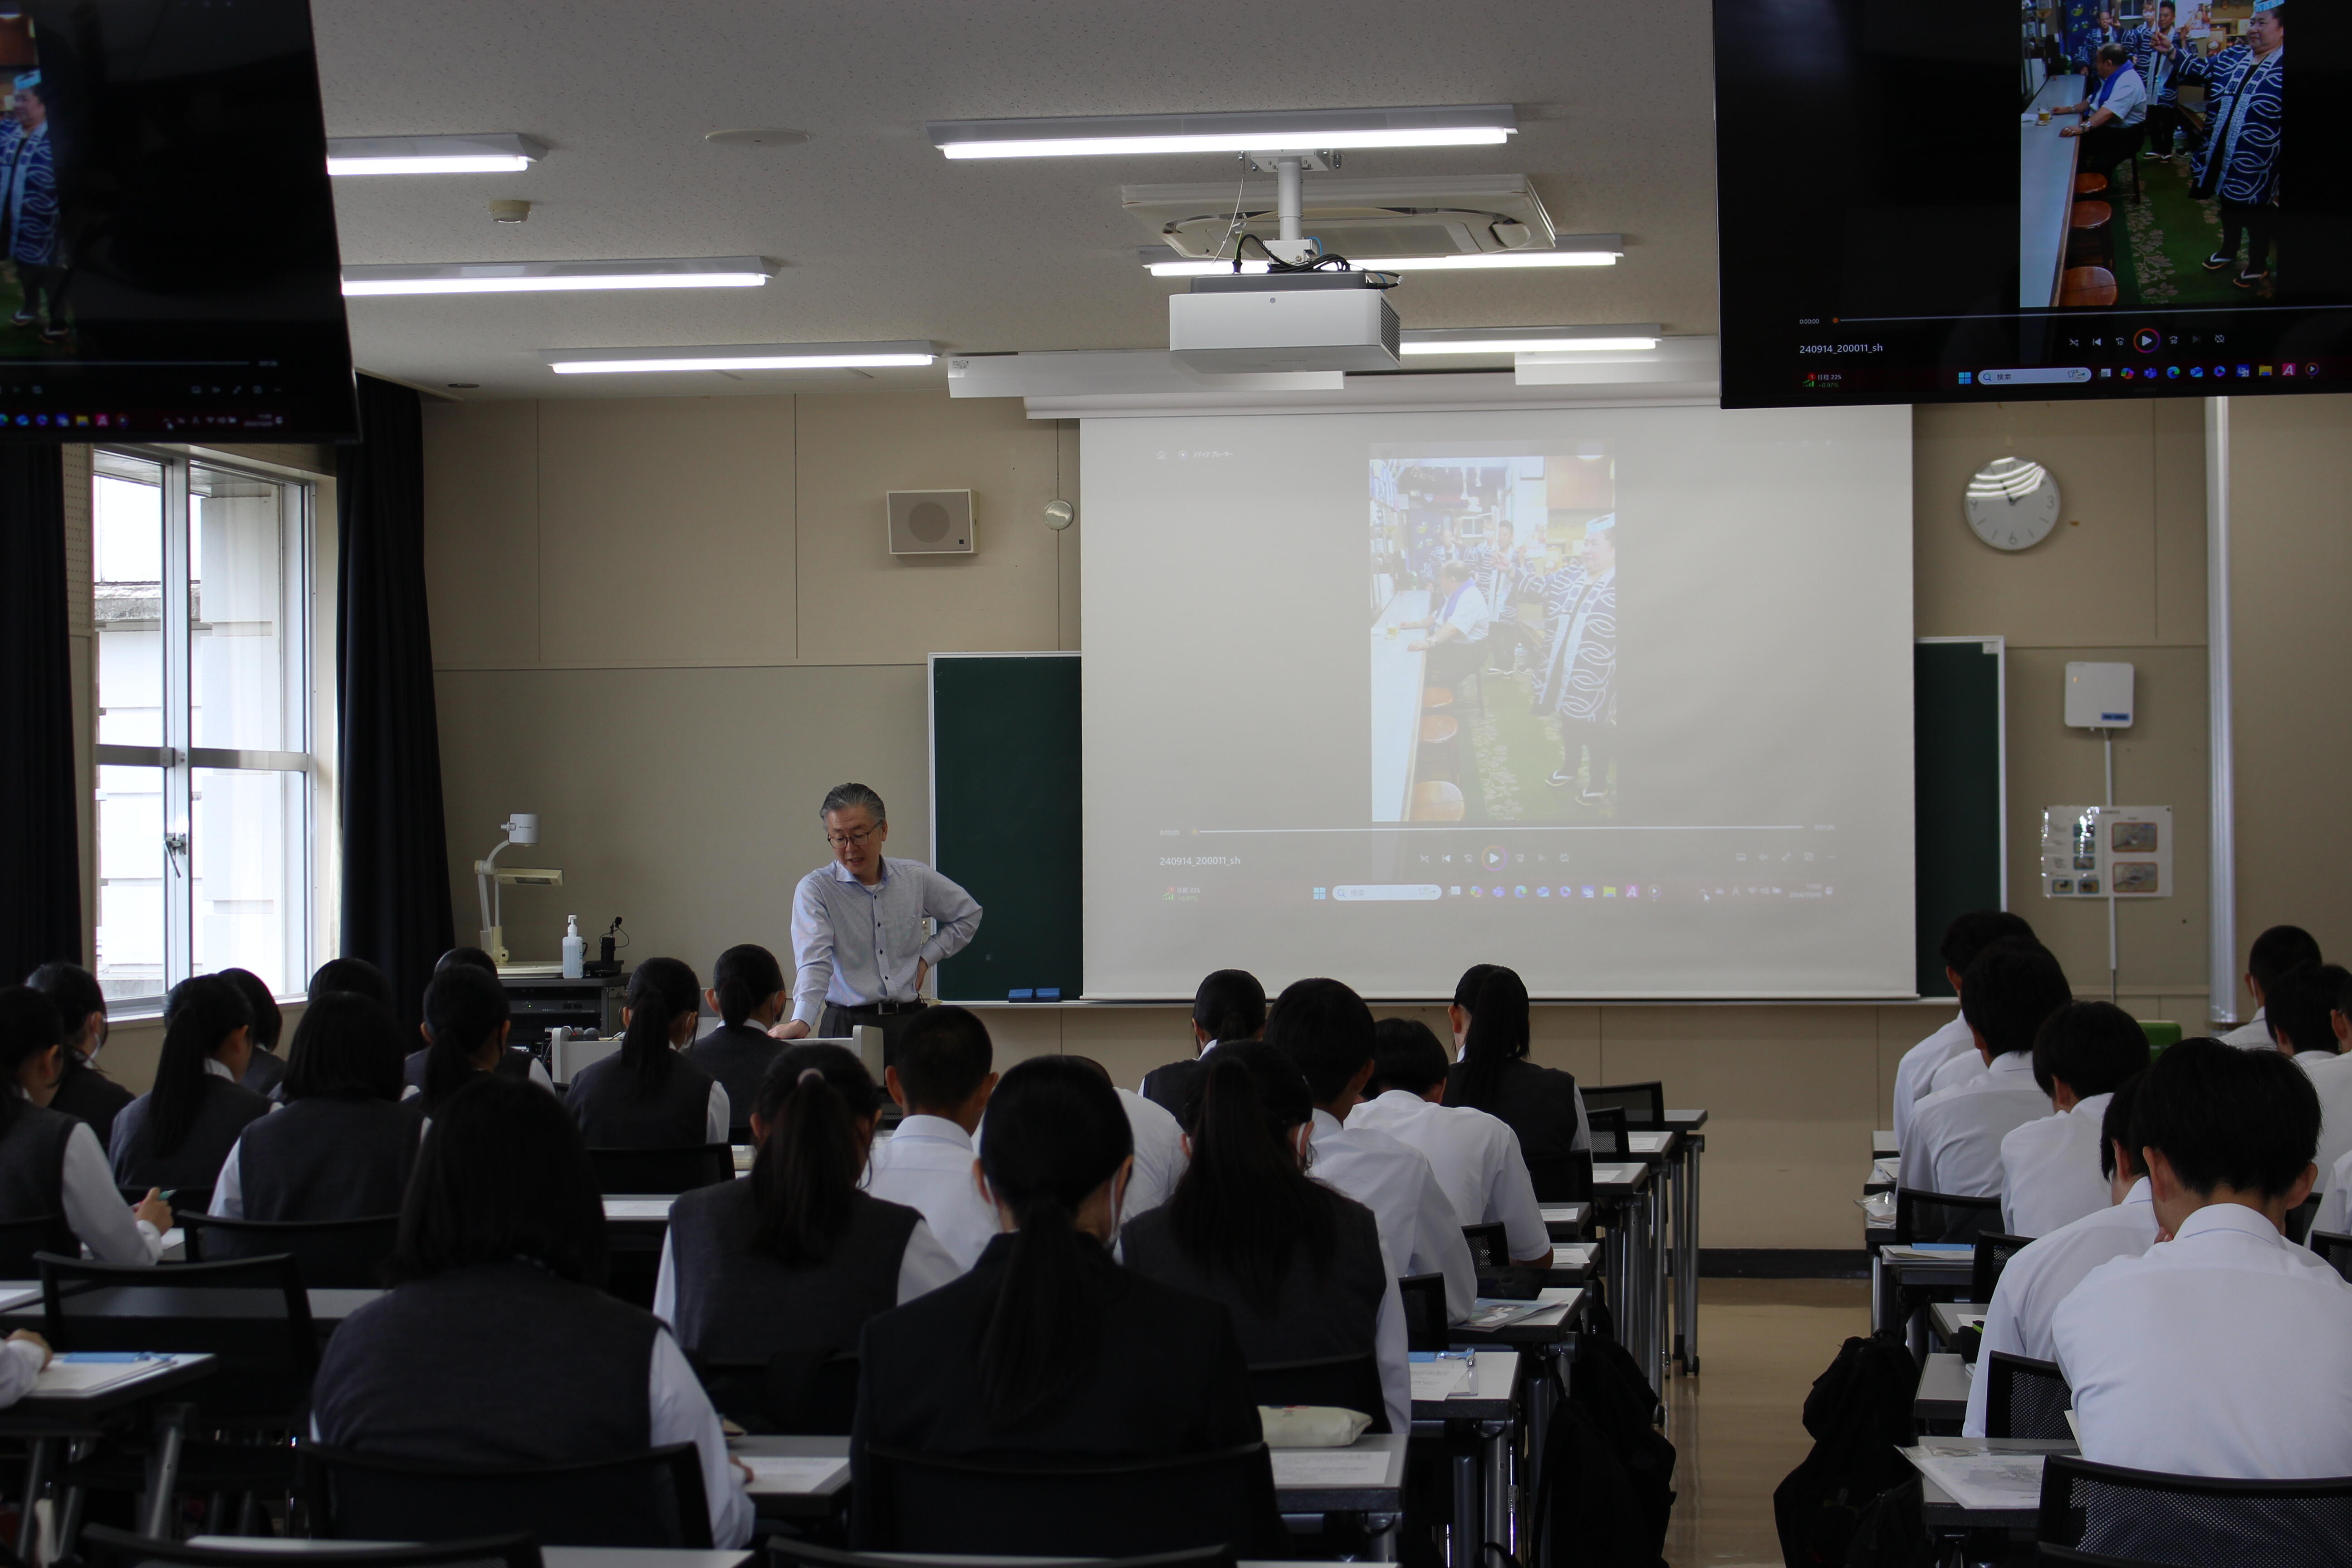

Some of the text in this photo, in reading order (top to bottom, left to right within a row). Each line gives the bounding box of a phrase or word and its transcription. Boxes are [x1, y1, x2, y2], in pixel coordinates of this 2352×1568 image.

[1800, 343, 1883, 354] 240914_200011_sh
[2047, 495, 2055, 509] 3
[2009, 531, 2017, 544] 6
[1160, 856, 1240, 867] 240914_200011_sh
